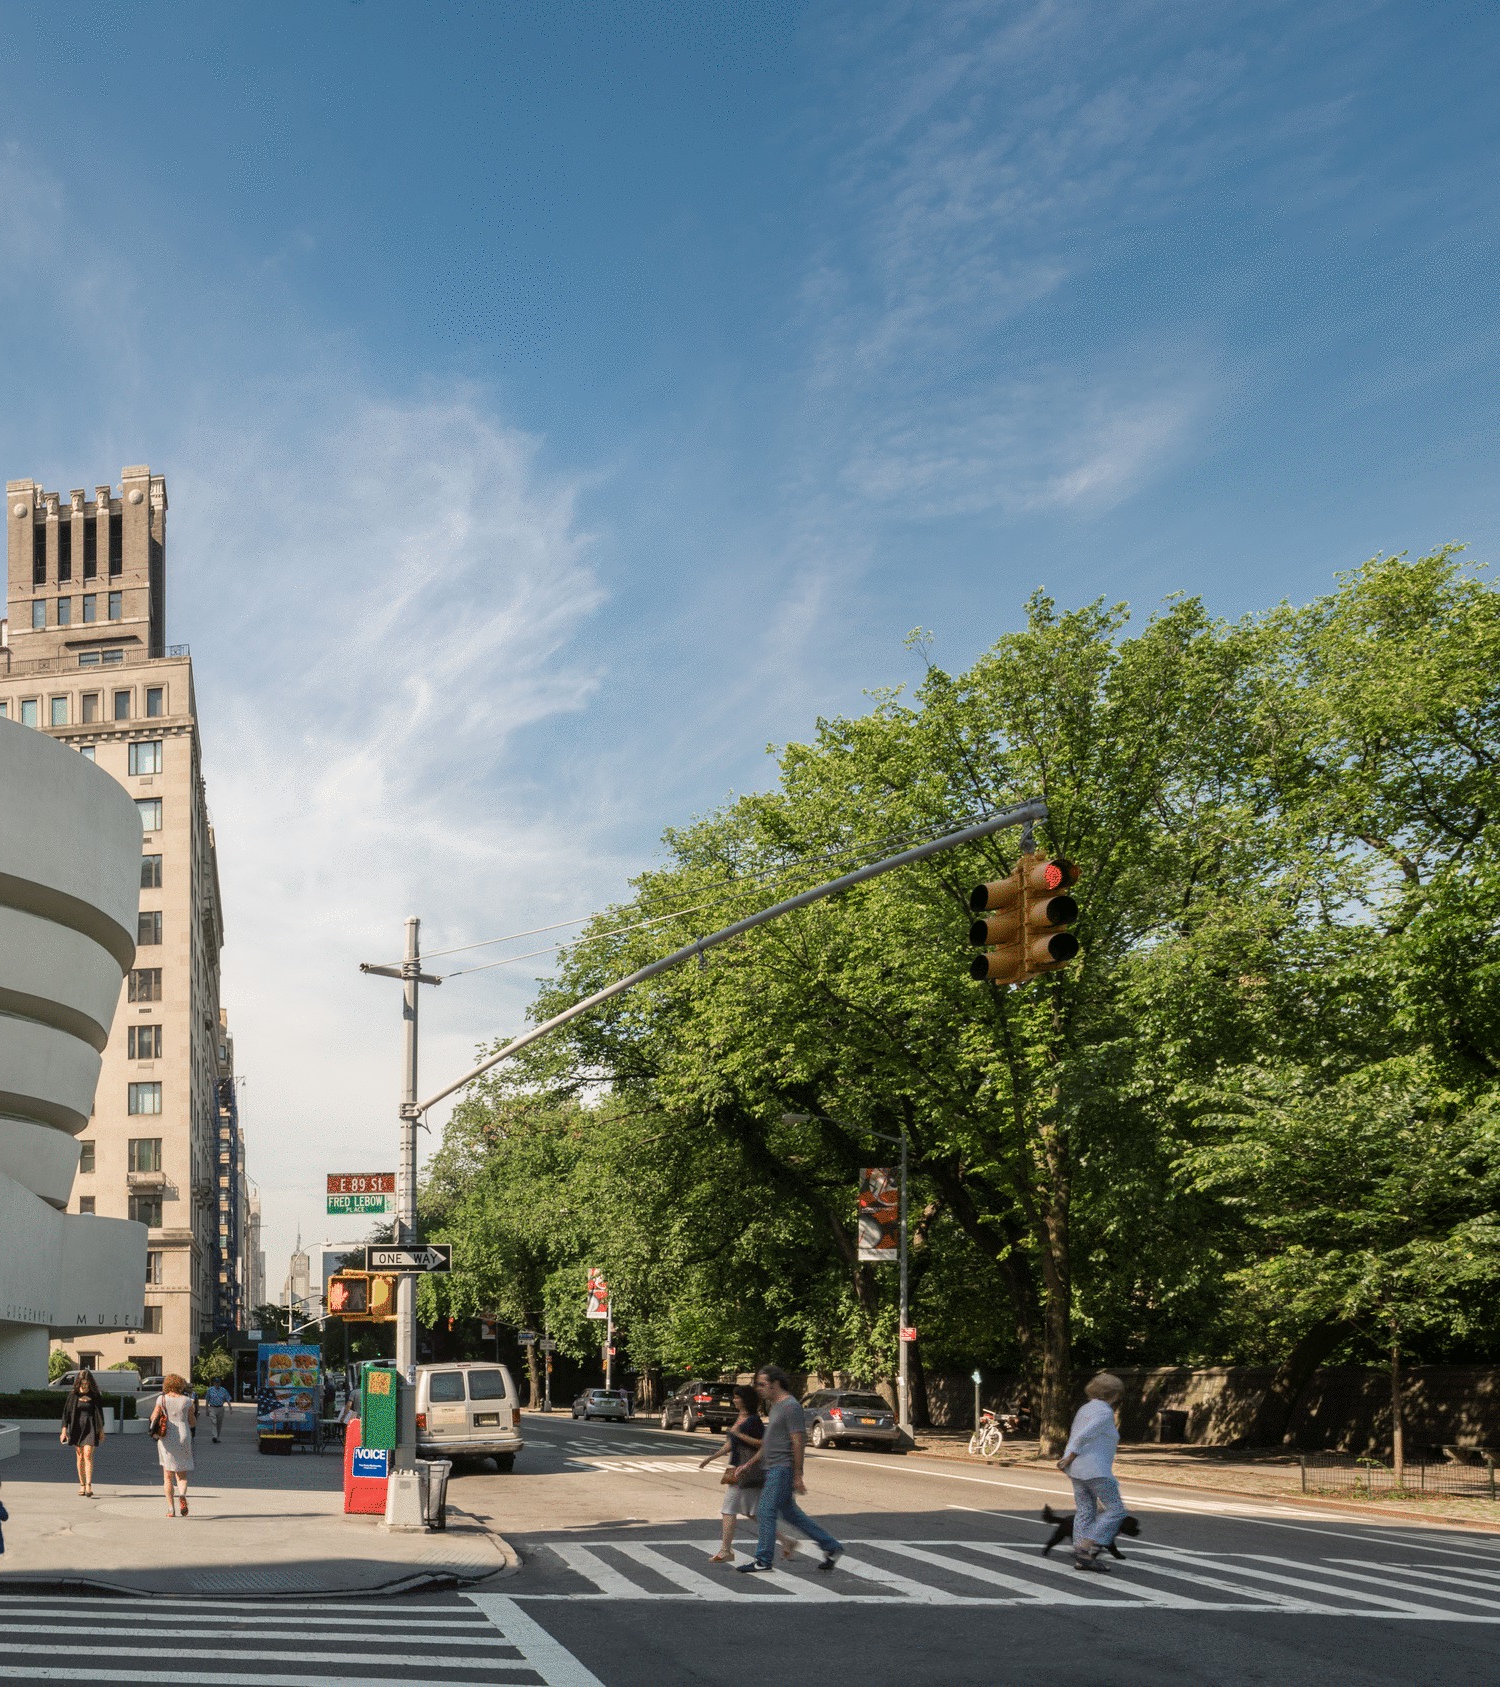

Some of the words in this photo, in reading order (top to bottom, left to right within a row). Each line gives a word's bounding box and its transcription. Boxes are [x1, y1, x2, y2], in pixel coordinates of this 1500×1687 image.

[340, 1178, 347, 1192] E
[351, 1178, 366, 1192] 89
[328, 1197, 351, 1207] FRED
[354, 1196, 383, 1207] LEBOW
[378, 1253, 403, 1264] ONE
[413, 1253, 438, 1264] WAY
[356, 1448, 386, 1460] VOICE
